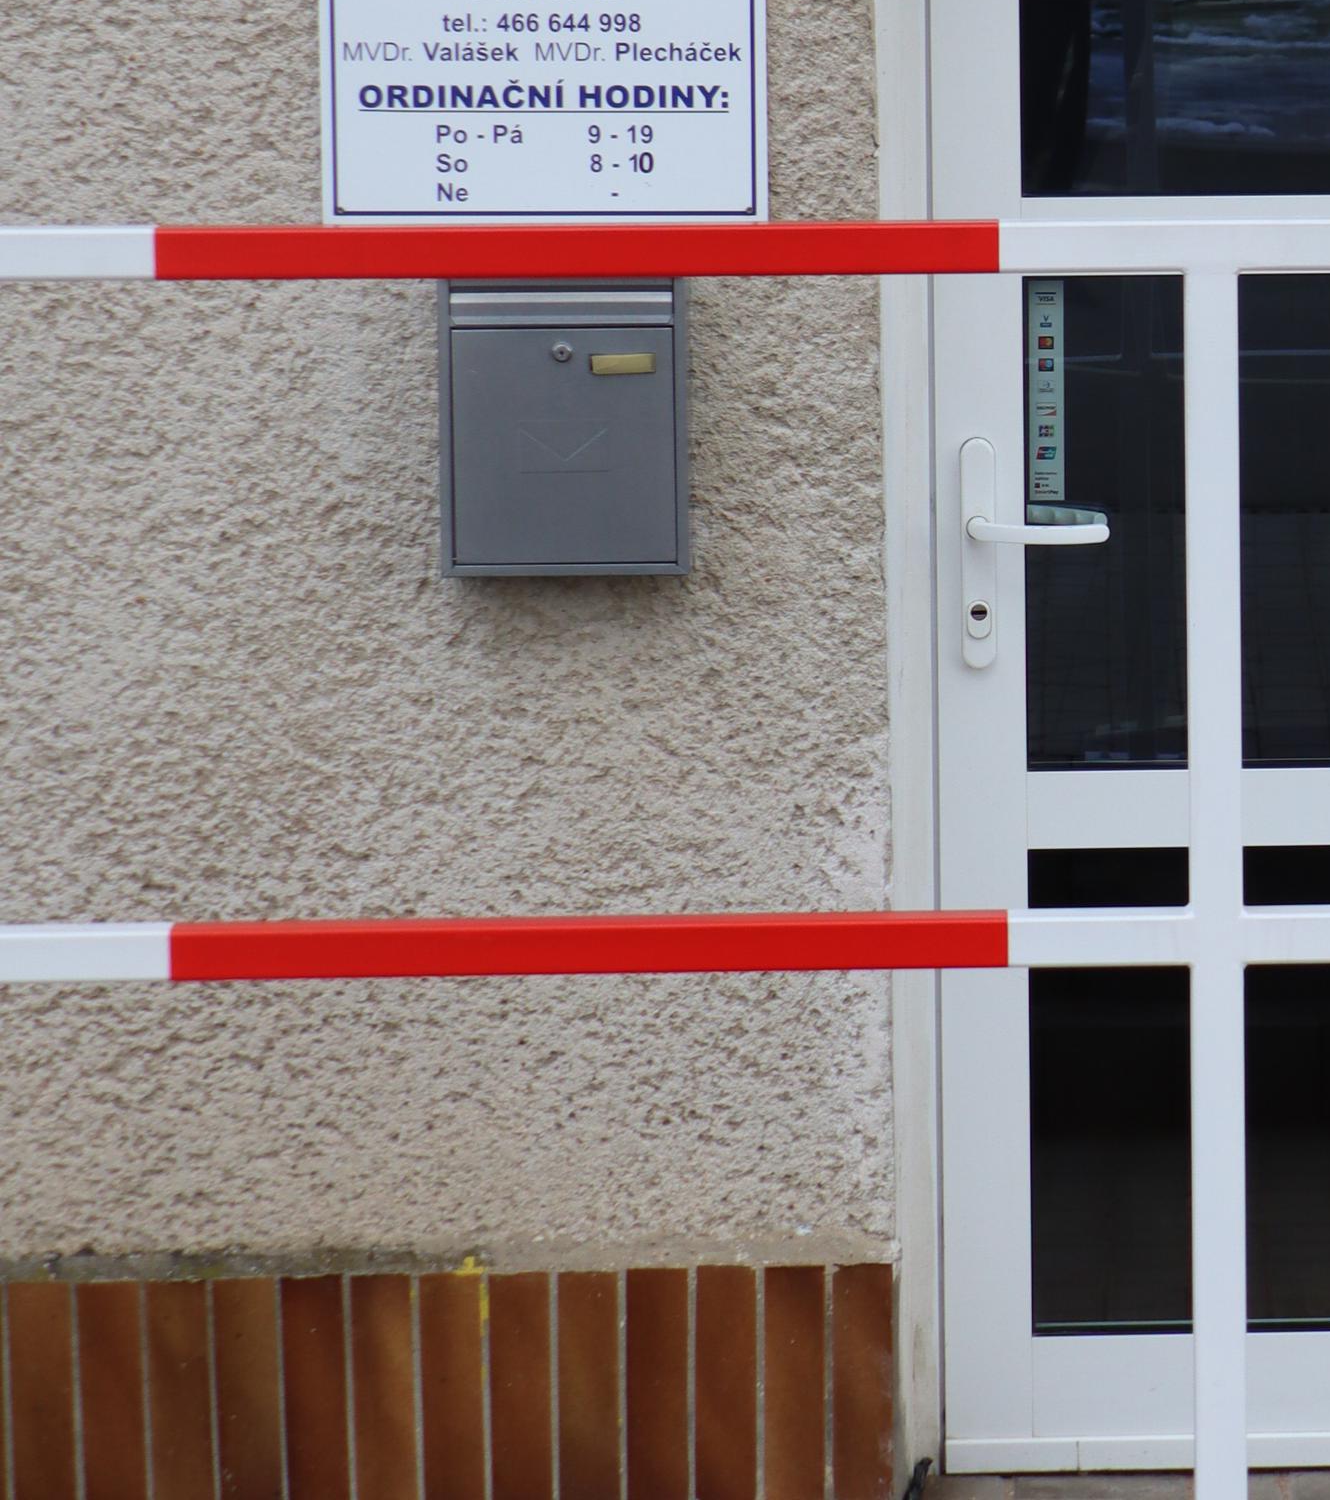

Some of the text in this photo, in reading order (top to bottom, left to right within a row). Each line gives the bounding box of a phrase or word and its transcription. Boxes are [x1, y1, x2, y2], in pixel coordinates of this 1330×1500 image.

[442, 13, 642, 33] tel.: 466 644 998
[343, 41, 742, 62] MVDr. Valášek MVDr. Plecháček
[358, 79, 729, 109] ORDINAČNÍ HODINY:
[436, 124, 468, 144] Po
[493, 124, 524, 144] Pá
[588, 124, 601, 144] 9
[626, 124, 654, 144] 19
[436, 153, 468, 173] So
[590, 153, 603, 173] 8
[628, 151, 654, 174] 10
[437, 182, 469, 203] Ne
